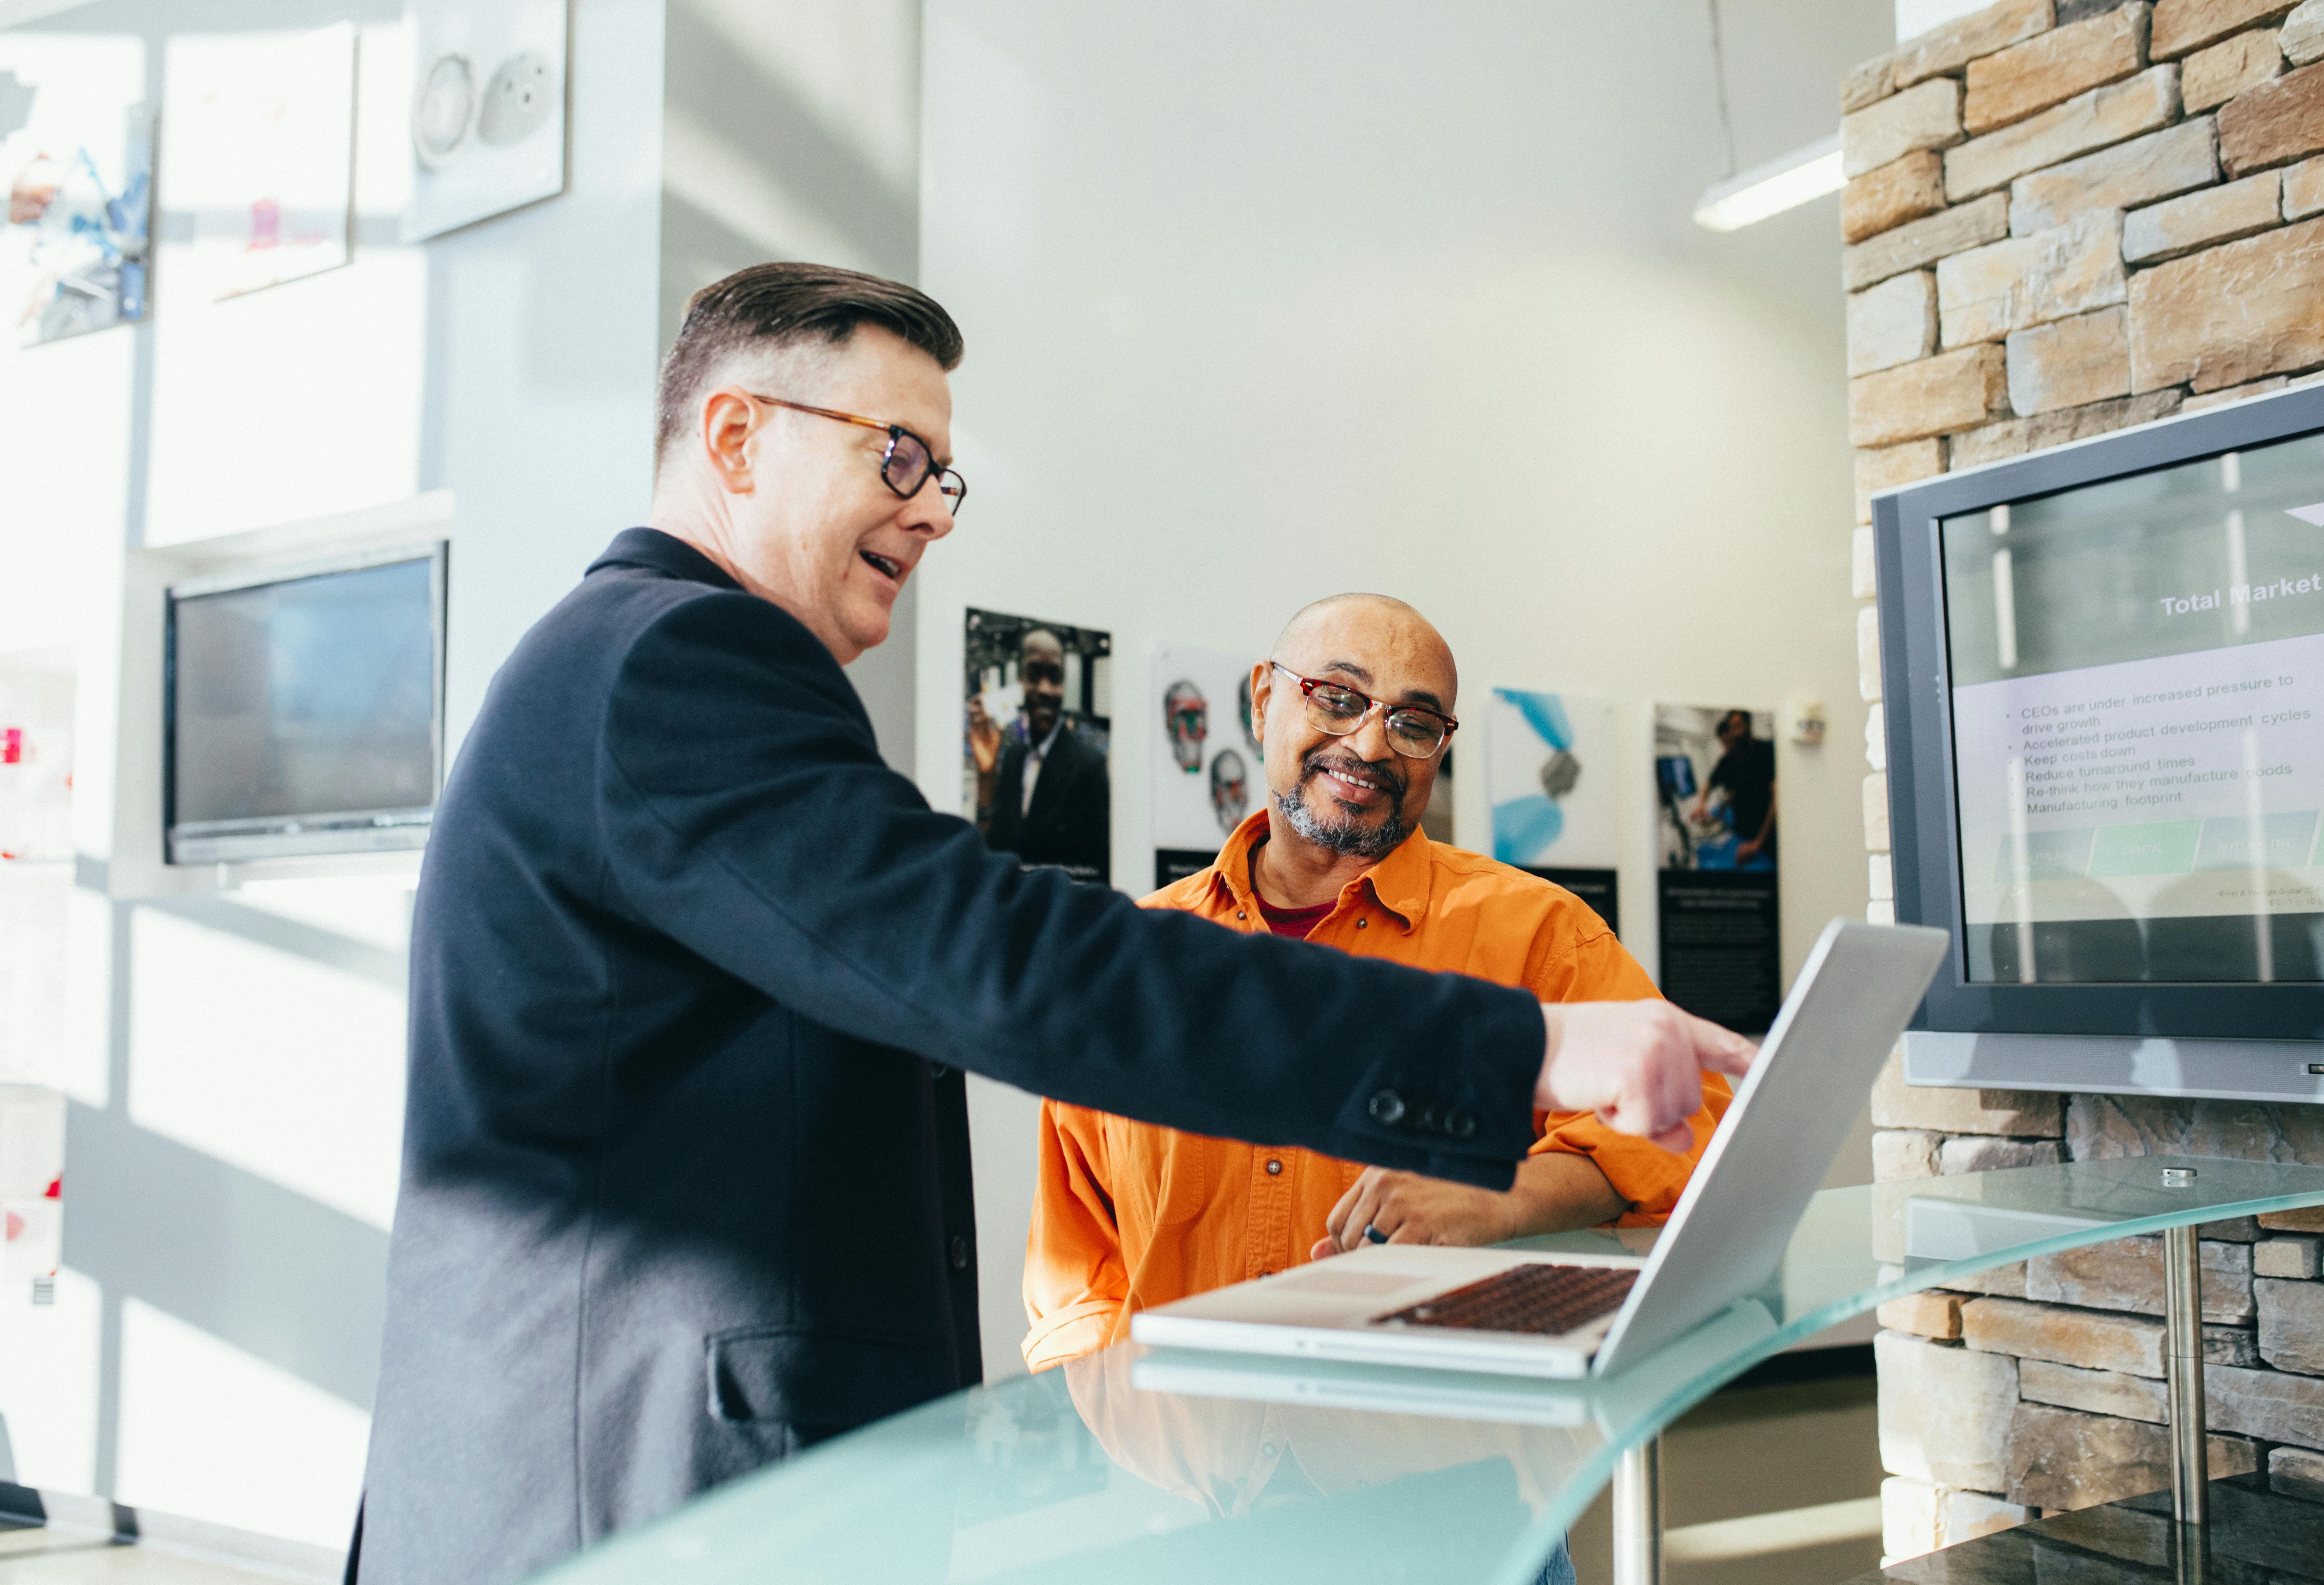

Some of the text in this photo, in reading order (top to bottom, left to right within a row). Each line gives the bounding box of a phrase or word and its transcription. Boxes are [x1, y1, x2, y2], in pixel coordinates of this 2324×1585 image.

[2161, 572, 2323, 616] Total Market
[2022, 675, 2293, 719] CEOs are under increased pressure to
[2022, 716, 2101, 735] drive growth
[2024, 709, 2311, 750] Accelerated product development cycles
[2025, 746, 2136, 766] Keep costs down
[2025, 757, 2196, 782] Reduce turnaround times
[2026, 783, 2079, 797] Re-think
[2084, 781, 2111, 793] how
[2116, 778, 2145, 790] they
[2150, 770, 2238, 787] manufacture
[2027, 791, 2181, 814] Manufacturing footprint
